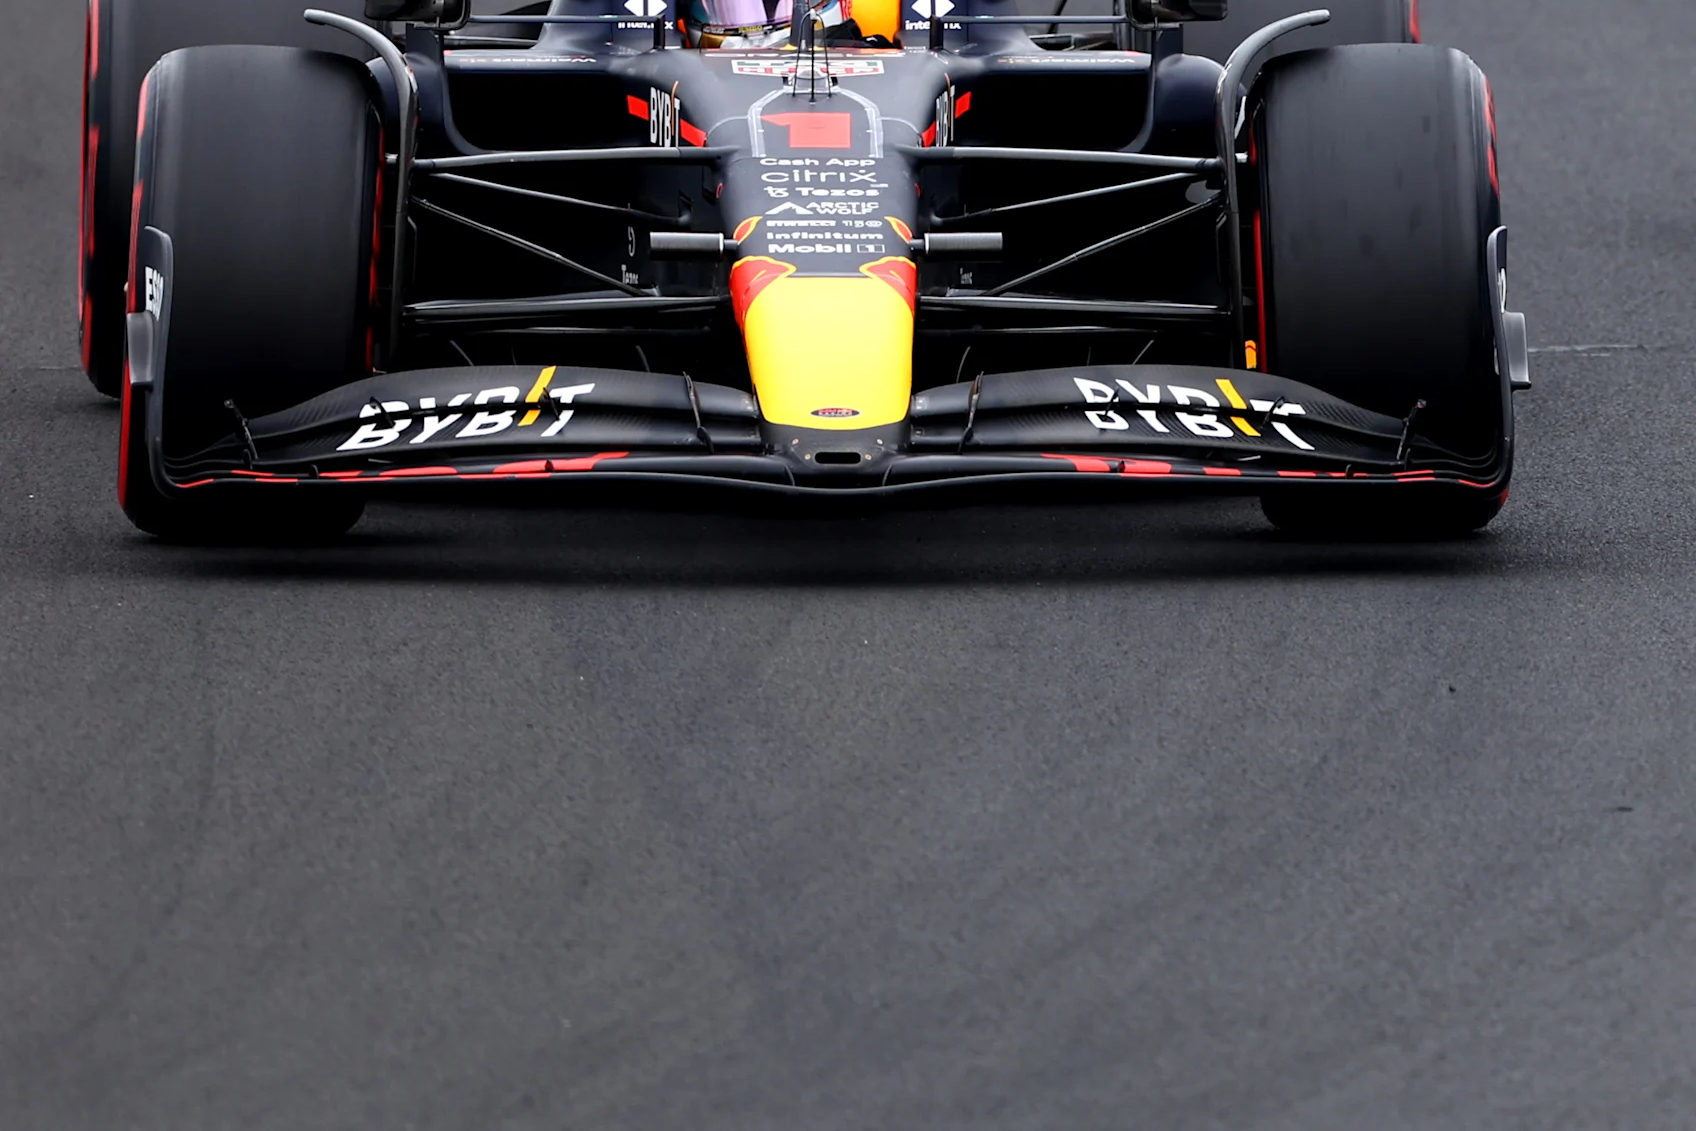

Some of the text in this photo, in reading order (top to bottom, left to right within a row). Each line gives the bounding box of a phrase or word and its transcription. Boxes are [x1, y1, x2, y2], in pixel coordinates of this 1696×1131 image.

[650, 80, 681, 148] BYBIT
[759, 112, 852, 148] 1
[760, 158, 876, 167] Cash App
[795, 187, 880, 196] Tezos
[768, 244, 852, 253] Mobil
[336, 366, 595, 450] BYBIT
[1072, 377, 1315, 451] BYBIT
